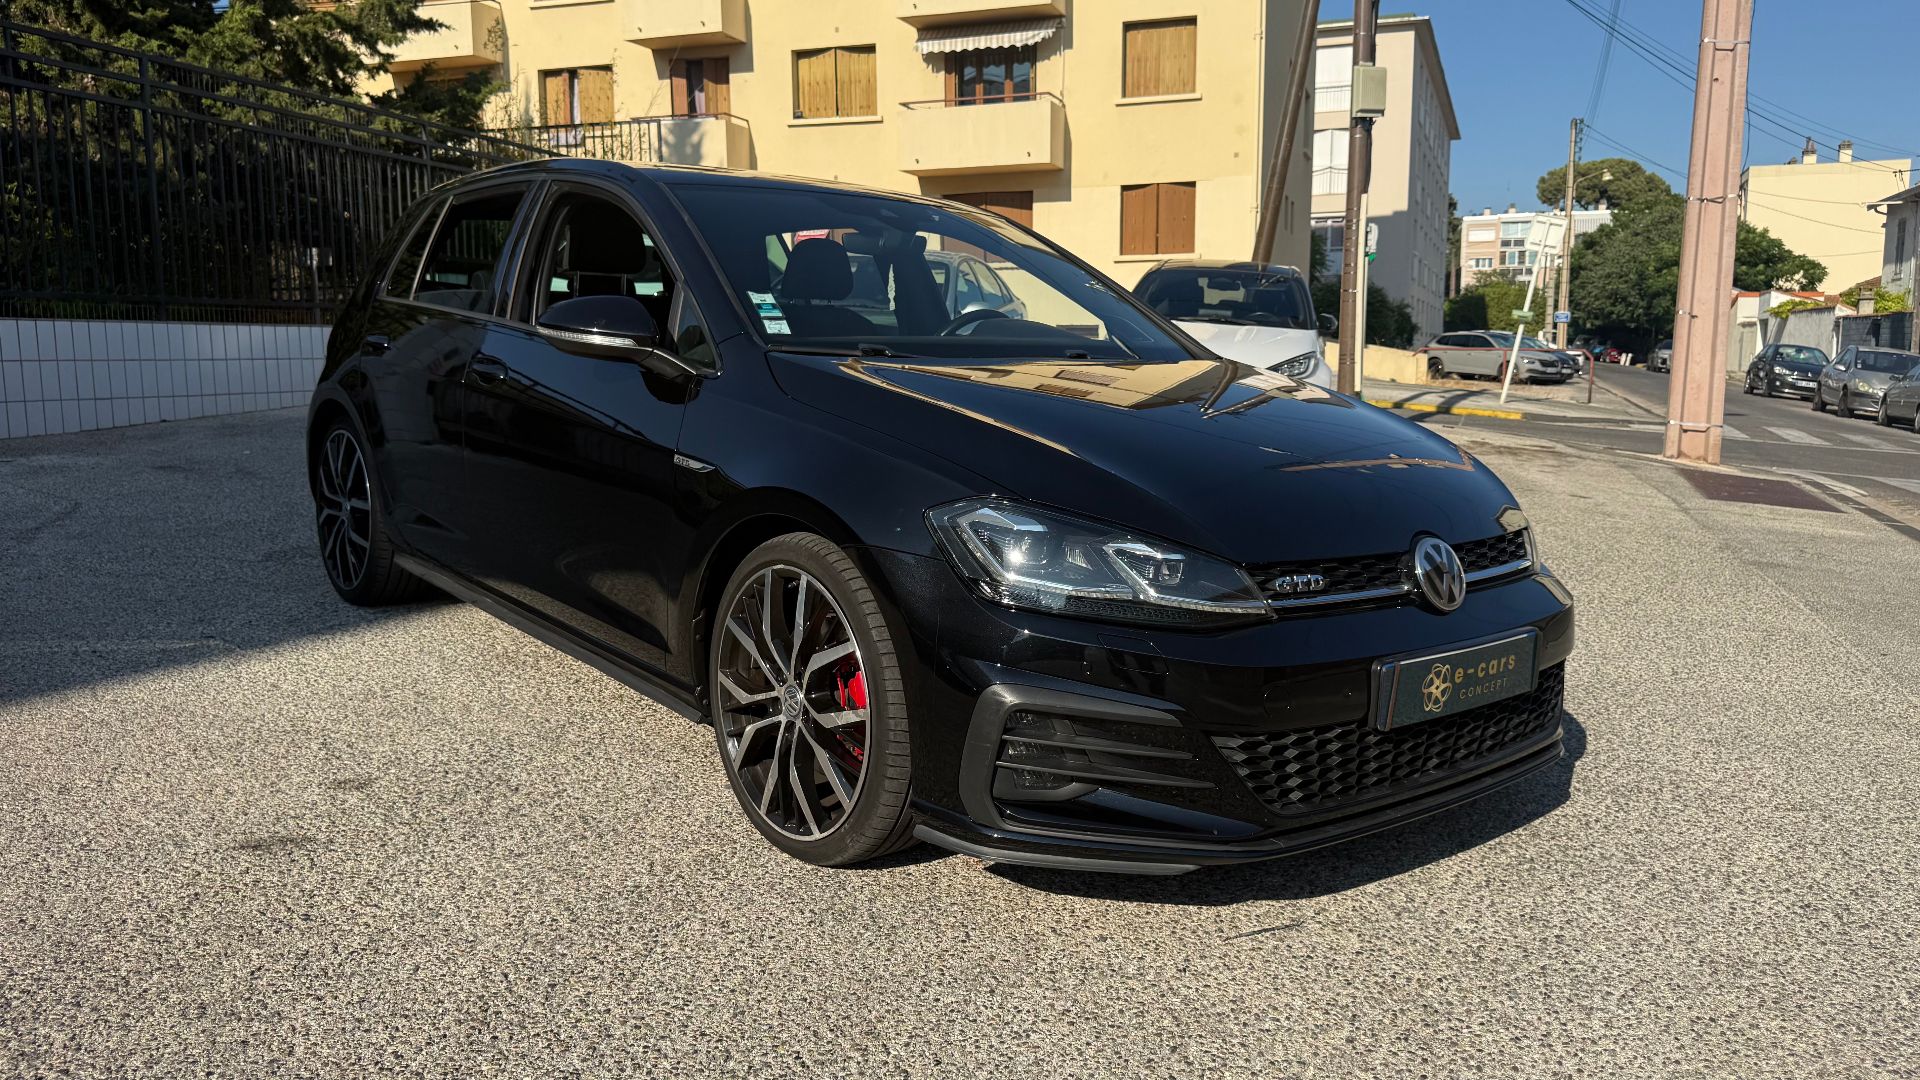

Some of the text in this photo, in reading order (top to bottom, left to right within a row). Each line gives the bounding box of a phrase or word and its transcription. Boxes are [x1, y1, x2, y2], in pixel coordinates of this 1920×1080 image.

[1275, 574, 1325, 593] GTD
[1455, 655, 1515, 684] e-cars
[1460, 678, 1507, 699] CONCEPT
